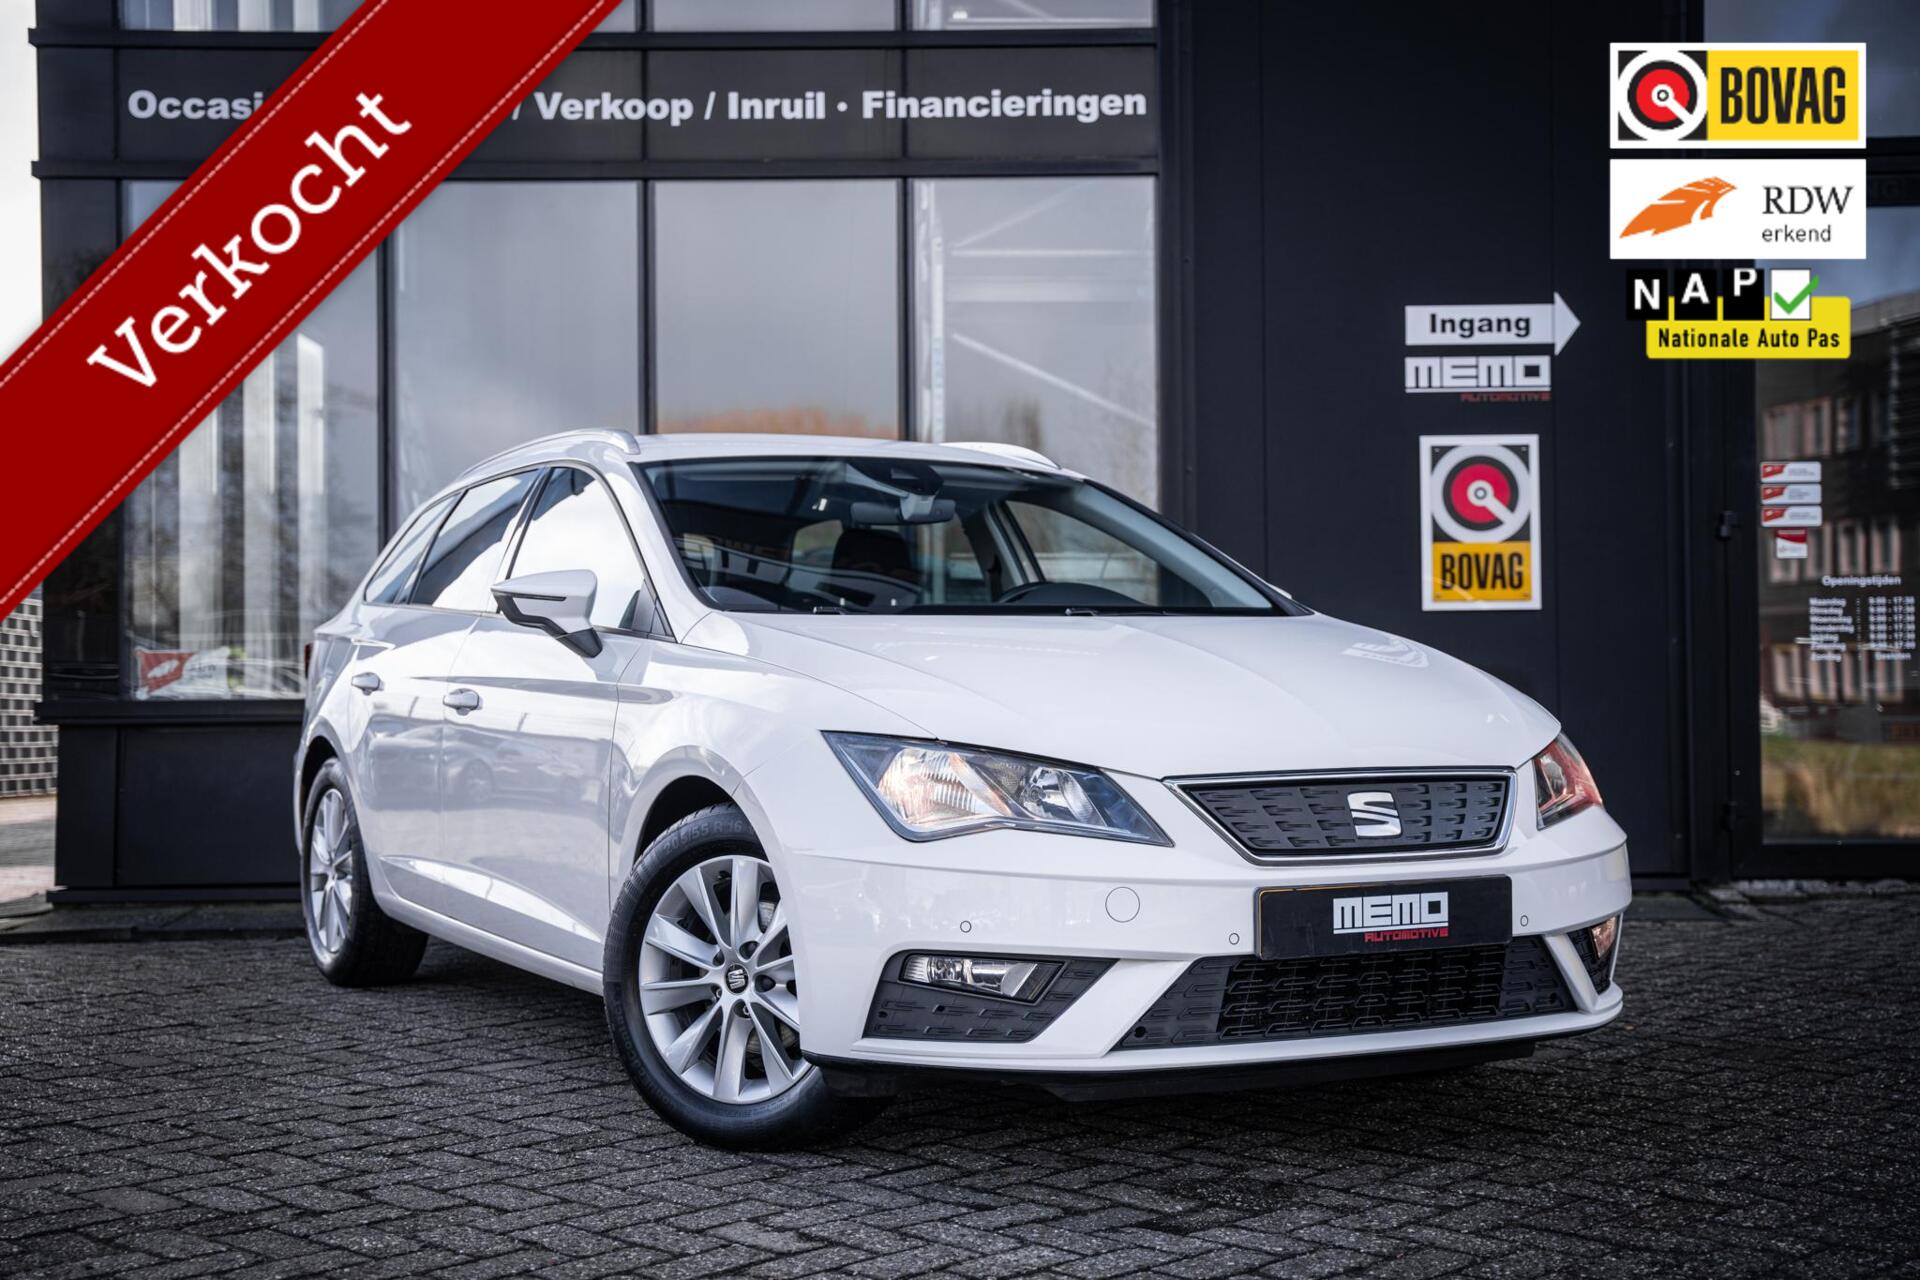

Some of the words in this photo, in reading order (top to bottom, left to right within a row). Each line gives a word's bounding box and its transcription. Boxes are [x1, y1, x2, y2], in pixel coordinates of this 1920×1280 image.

[128, 90, 264, 120] Occasi
[534, 91, 694, 127] Verkoop
[727, 91, 826, 120] Inruil
[862, 88, 1147, 124] Financieringen
[1429, 313, 1531, 339] Ingang
[1405, 356, 1551, 389] MEMO
[1440, 552, 1524, 591] BOVAG
[1333, 891, 1449, 930] MEMO
[1364, 927, 1449, 943] AUTOMOTIVE
